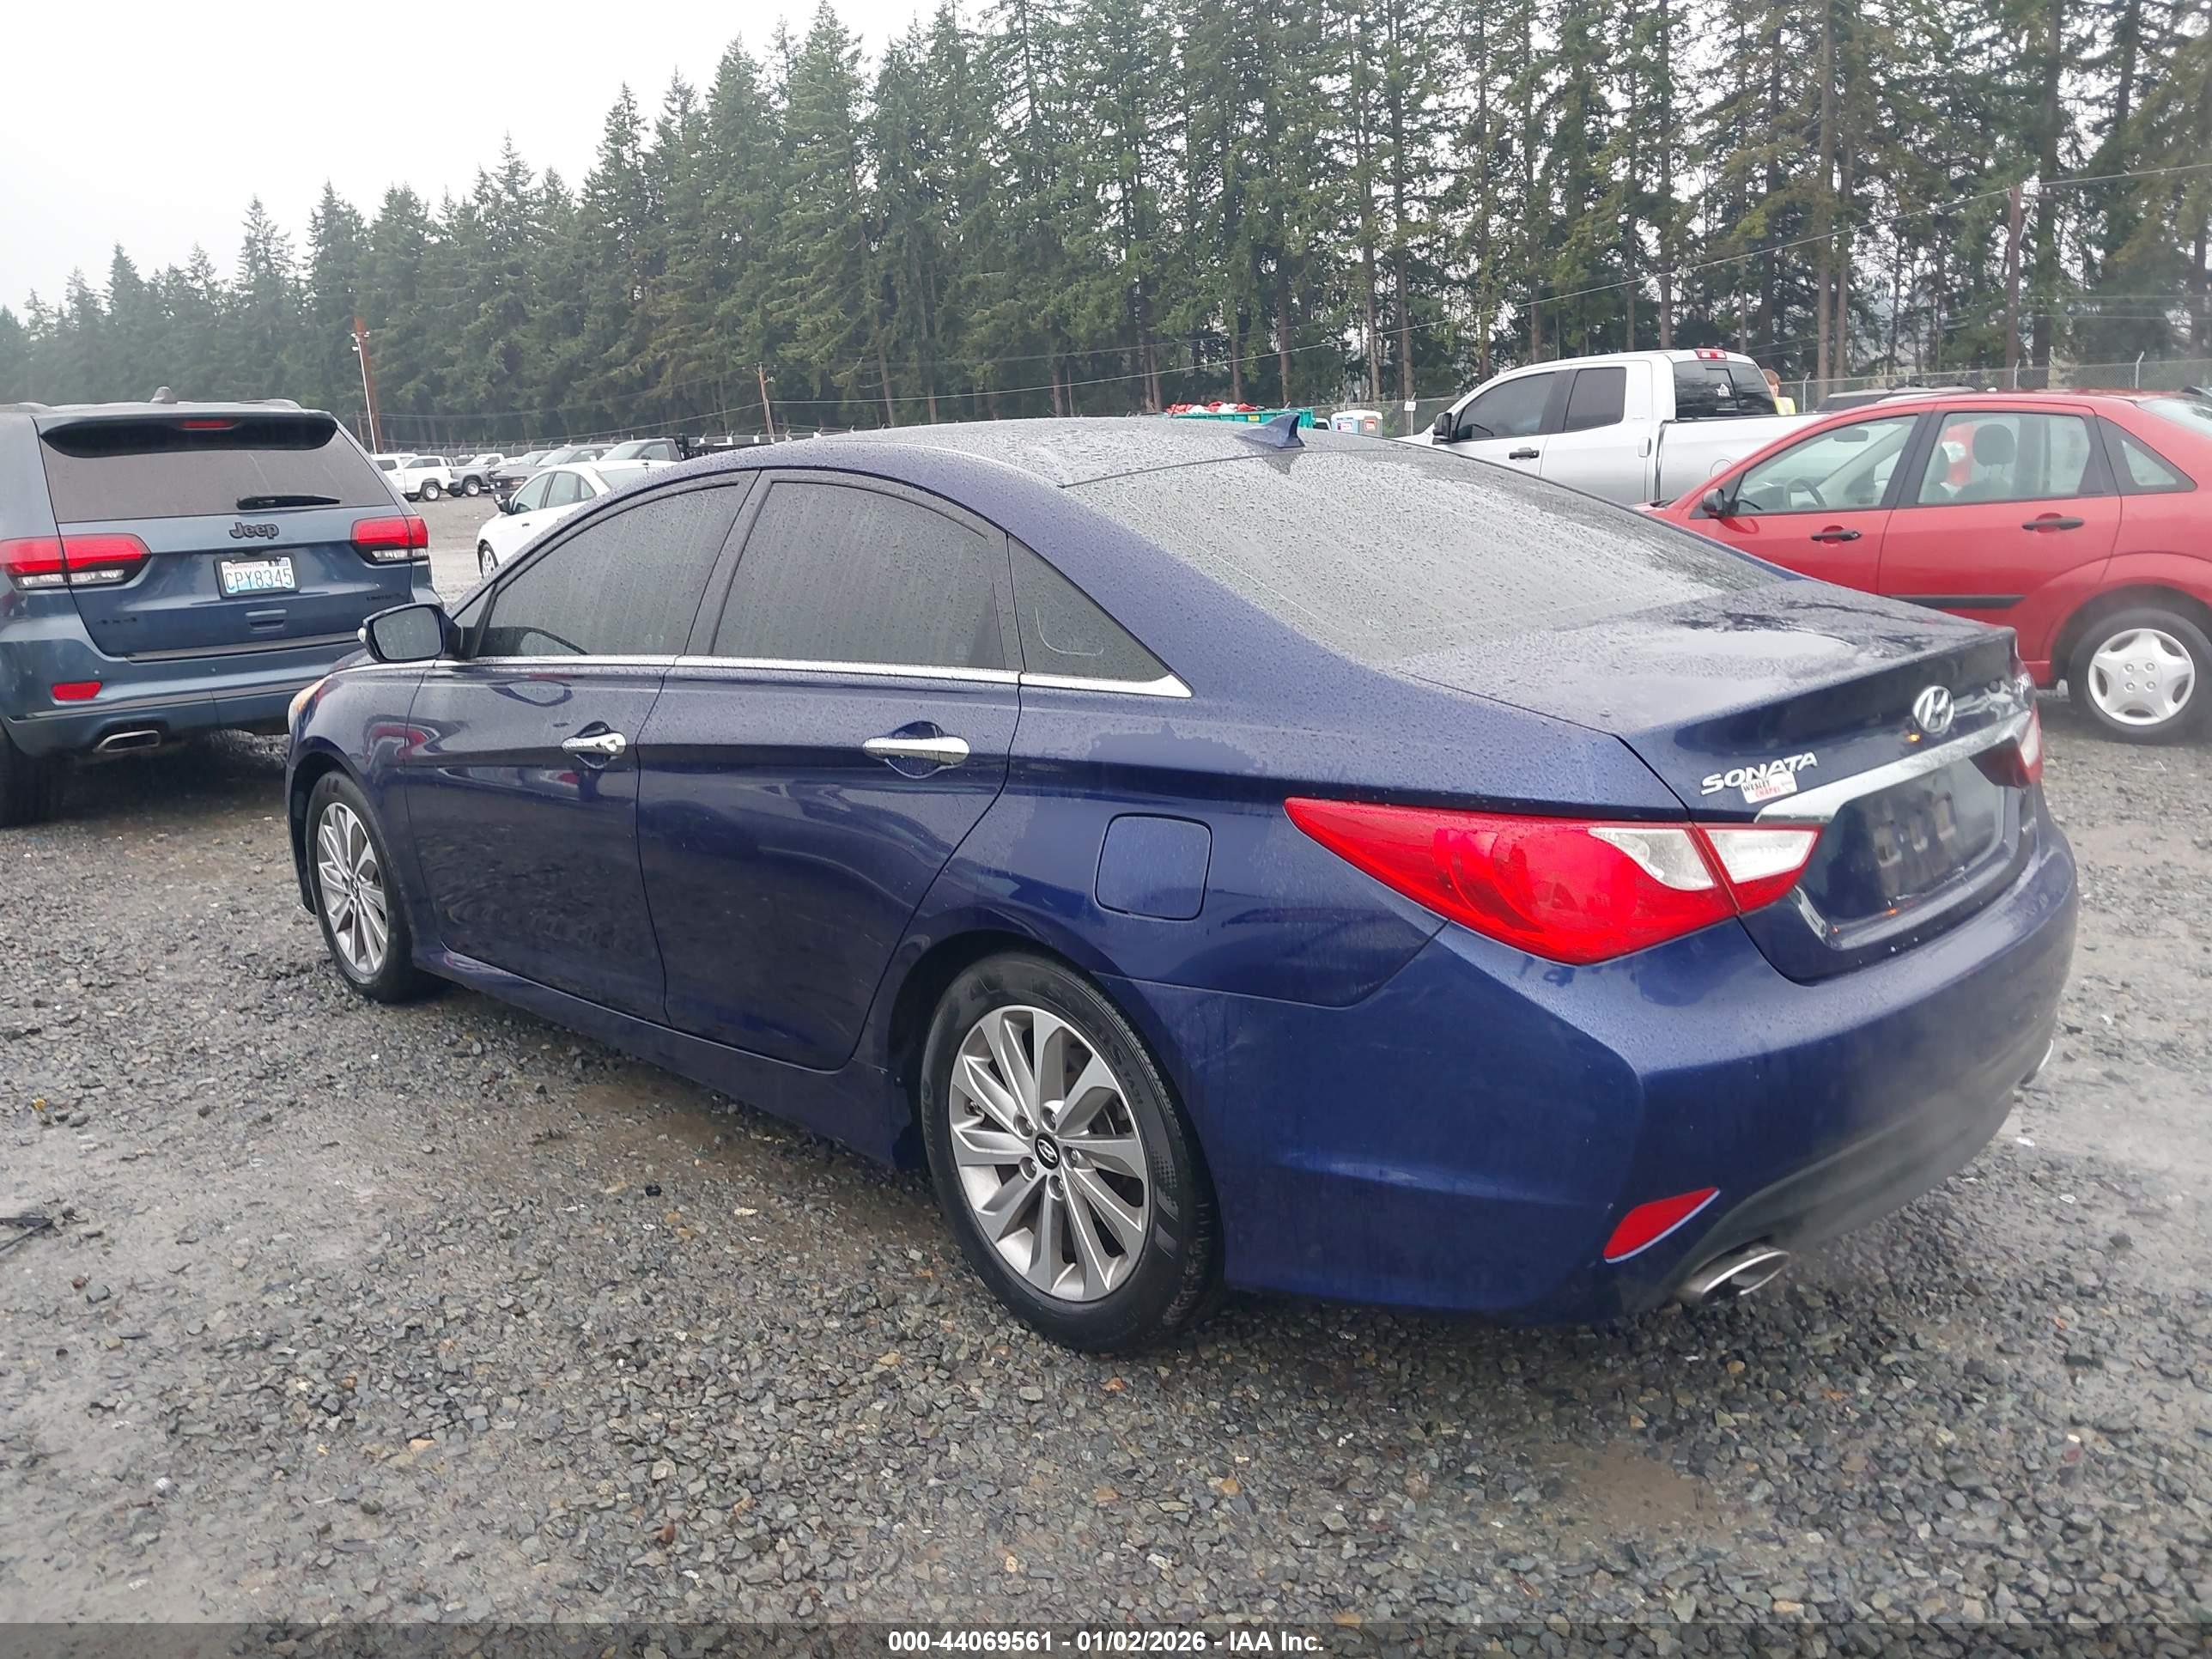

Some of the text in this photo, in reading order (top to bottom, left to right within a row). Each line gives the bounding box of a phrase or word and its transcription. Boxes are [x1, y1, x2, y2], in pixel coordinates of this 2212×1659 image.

[229, 521, 280, 539] Jeep
[225, 568, 293, 591] CPY8345
[1700, 751, 1818, 795] SONATA
